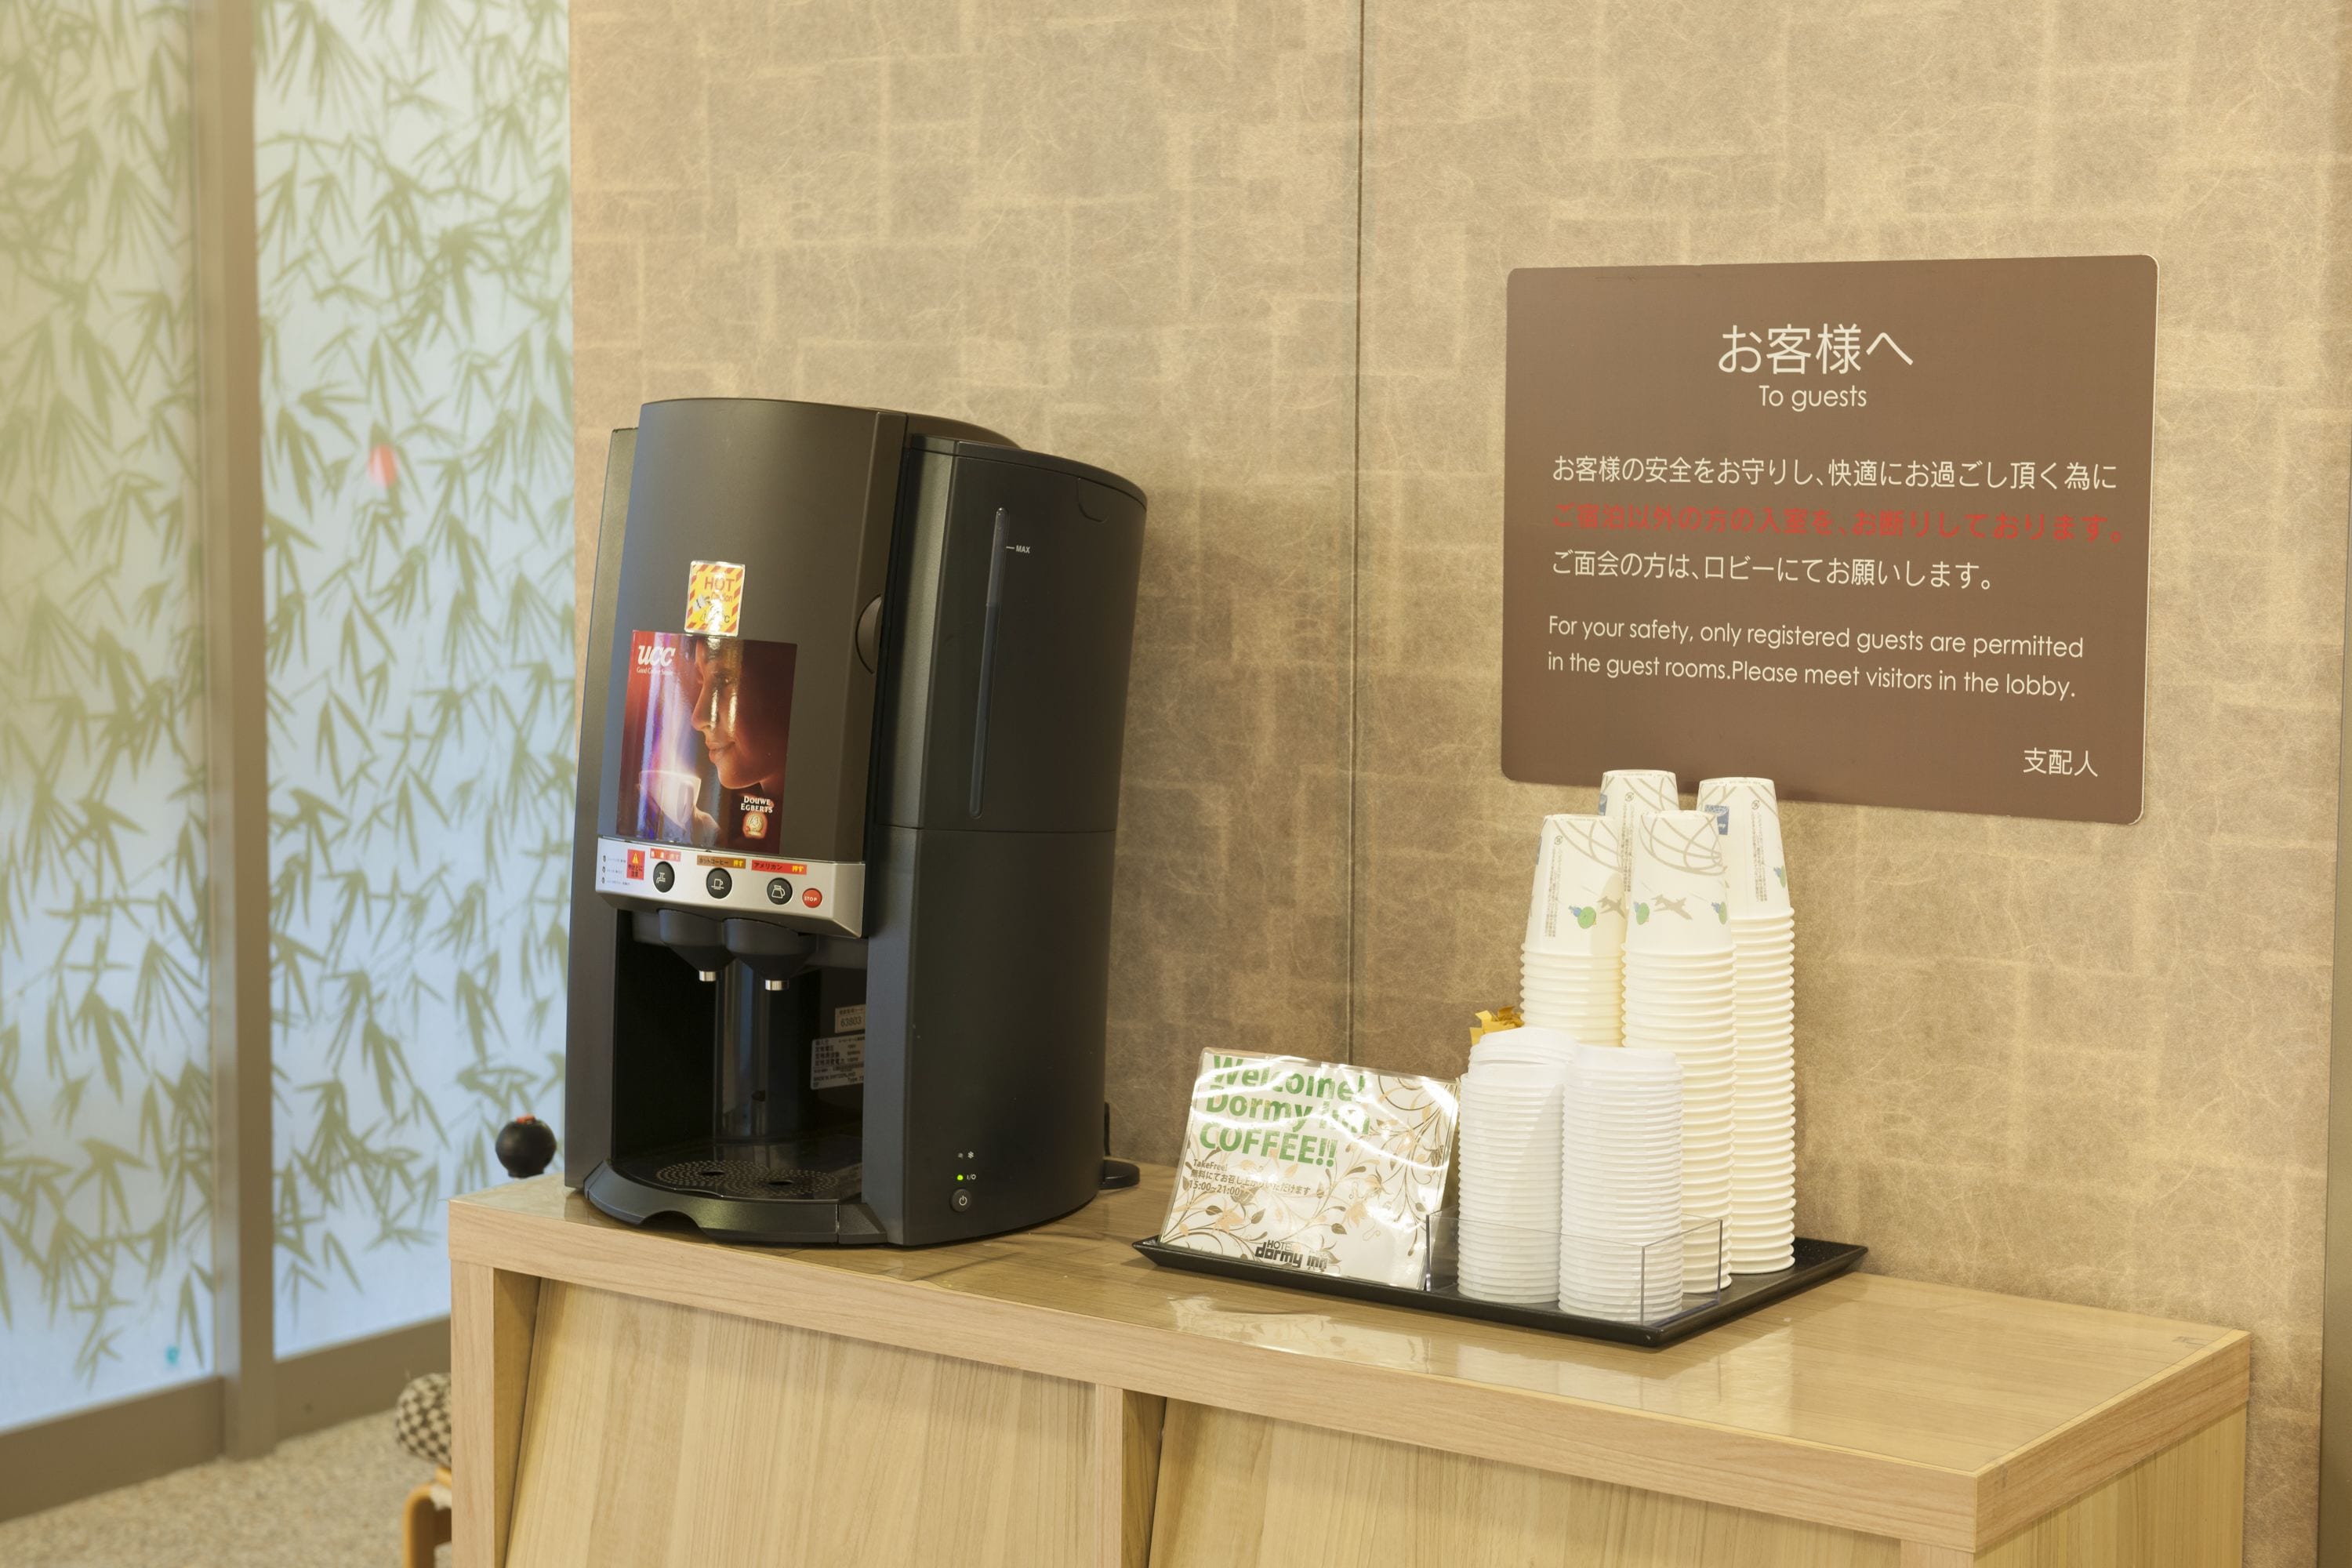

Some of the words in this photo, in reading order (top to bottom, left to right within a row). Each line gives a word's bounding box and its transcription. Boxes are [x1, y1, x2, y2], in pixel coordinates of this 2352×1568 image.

[1719, 323, 1914, 375] お客様へ
[1759, 384, 1784, 406] To
[1791, 384, 1867, 412] guests
[1552, 455, 2118, 491] お客様の安全をお守りし、快適にお過ごし頂く為に
[1552, 502, 2123, 543] ご宿泊以外の方の入室を、お断りしております。
[1015, 545, 1031, 554] MAX
[704, 576, 735, 592] HOT
[1552, 549, 1991, 590] ご面会の方は、ロビーにてお願いします。
[1548, 615, 1578, 636] For
[1582, 621, 1625, 640] your
[1629, 619, 1694, 644] safety,
[1700, 622, 1742, 647] only
[1748, 624, 1850, 649] registered
[1857, 630, 1924, 653] guests
[1929, 636, 1966, 653] are
[1973, 634, 2084, 659] permitted
[1548, 651, 1564, 672] in
[1570, 652, 1601, 673] the
[1606, 656, 1661, 679] guest
[1804, 666, 1860, 686] meet
[1866, 666, 1933, 690] visitors
[1938, 670, 1956, 691] in
[1963, 671, 2000, 693] the
[2006, 673, 2076, 702] lobby.
[2023, 746, 2099, 779] 支配人
[740, 803, 774, 814] EGBERTS
[743, 795, 771, 806] DOUWE
[753, 862, 783, 871] アメリカン
[1206, 1084, 1313, 1133] Dormy
[1200, 1121, 1338, 1167] COFFEE!!
[1254, 1241, 1303, 1269] dormy
[1306, 1254, 1330, 1269] inn
[1267, 1240, 1294, 1252] HOTEL
